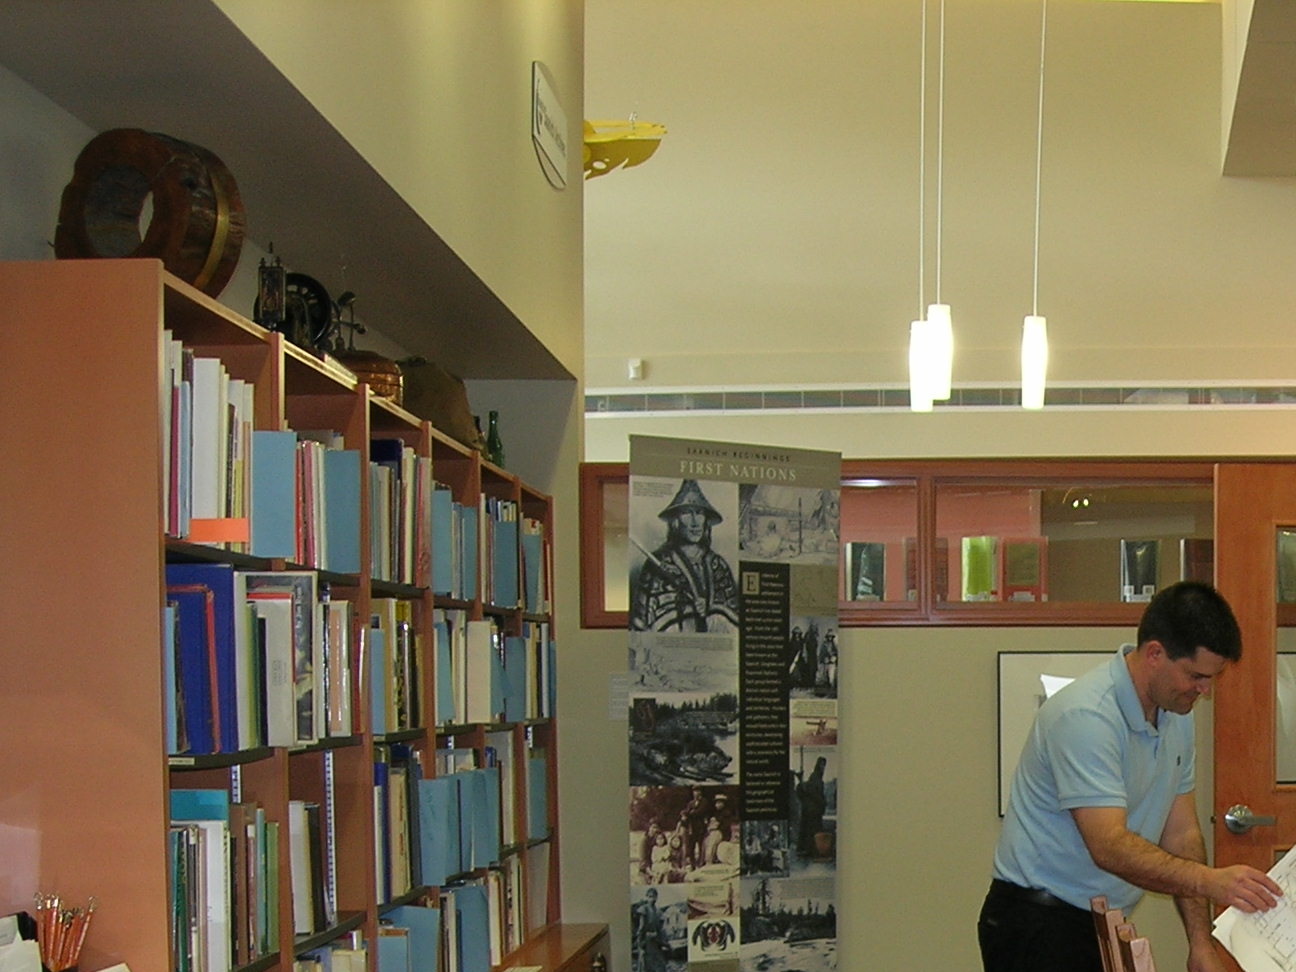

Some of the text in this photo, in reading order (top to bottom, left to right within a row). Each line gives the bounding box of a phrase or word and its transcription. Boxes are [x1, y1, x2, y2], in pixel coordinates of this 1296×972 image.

[687, 447, 791, 463] SAANICH BEGINNINGS
[680, 460, 797, 481] FIRST NATIONS
